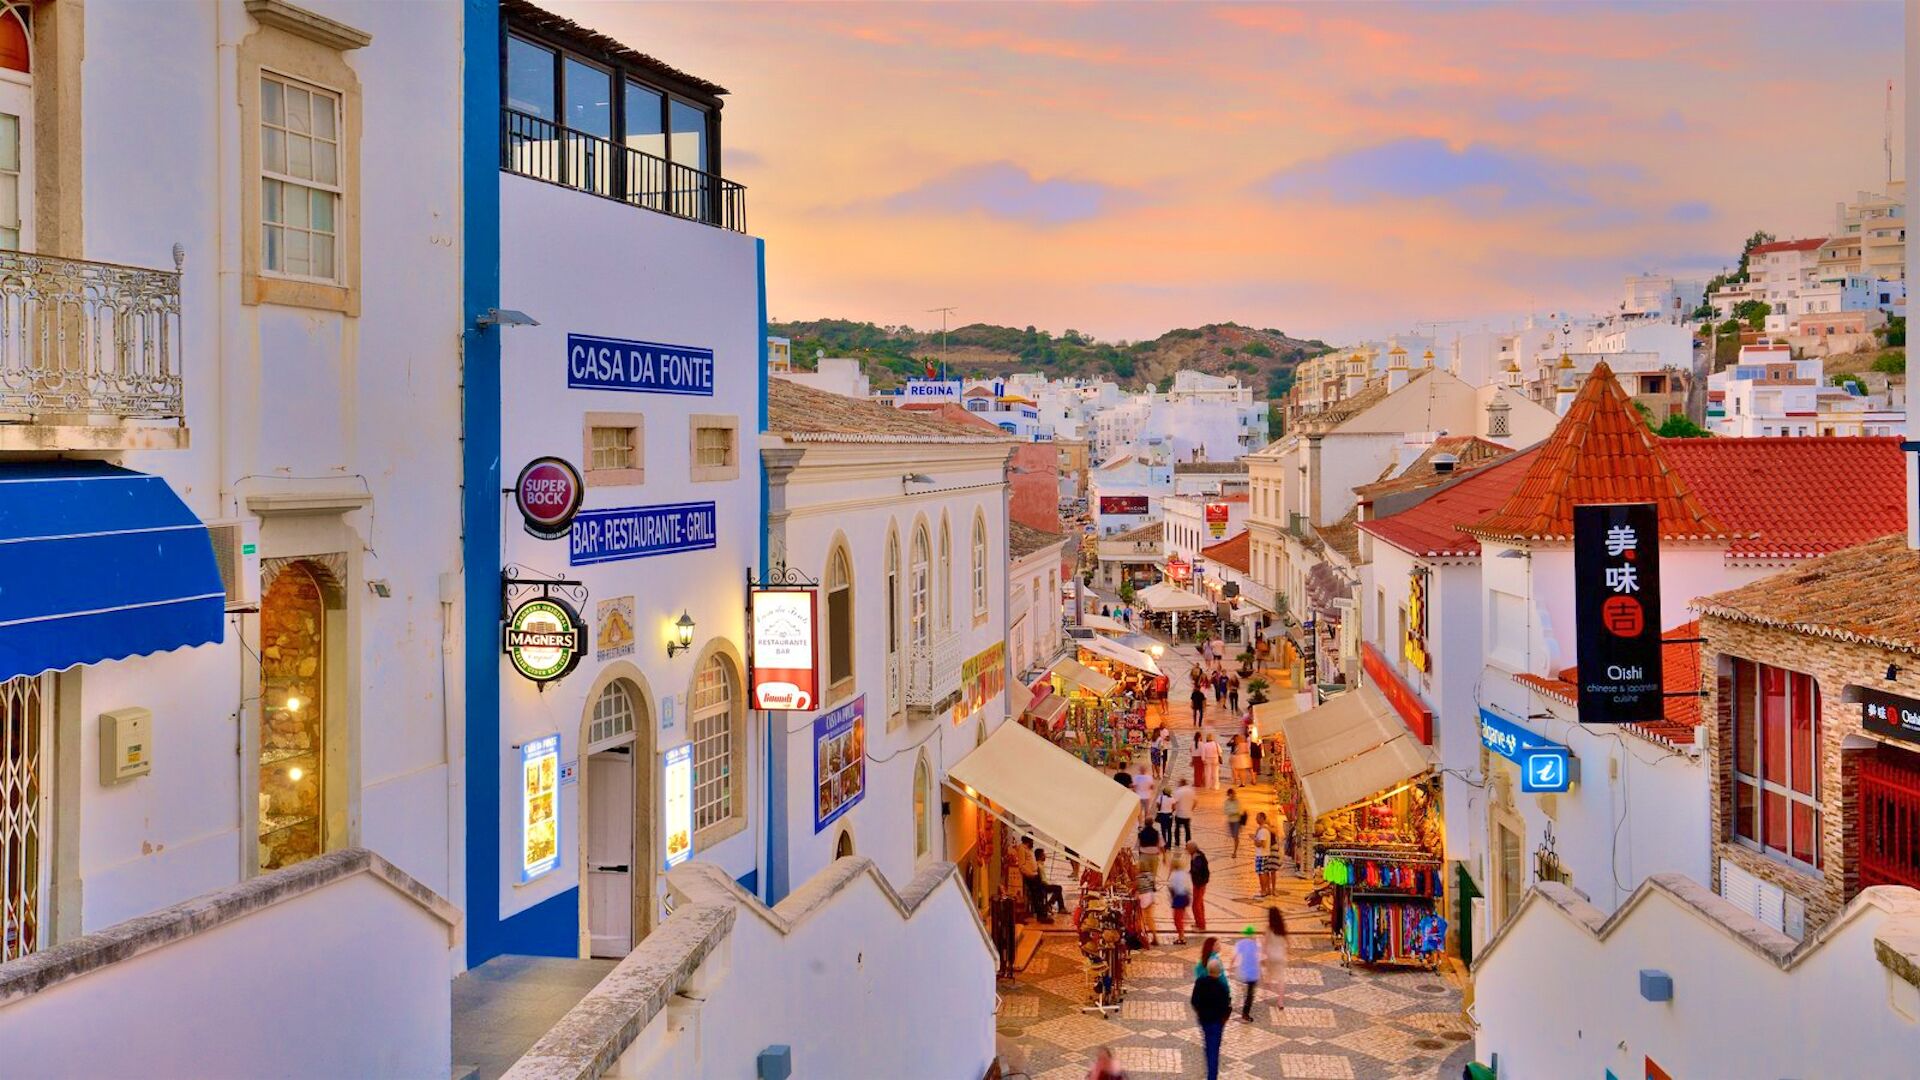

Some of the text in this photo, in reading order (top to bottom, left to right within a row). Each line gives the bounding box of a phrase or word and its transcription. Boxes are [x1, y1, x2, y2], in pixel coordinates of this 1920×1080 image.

[572, 345, 712, 388] CASA DA FONTE
[911, 386, 953, 395] REGINA
[525, 479, 566, 493] SUPER
[527, 491, 564, 505] BOCK
[511, 633, 573, 647] MAGNERS
[1607, 665, 1643, 681] Oishi
[1587, 683, 1618, 693] chinese
[1619, 684, 1625, 693] &
[1613, 695, 1639, 703] cuisine
